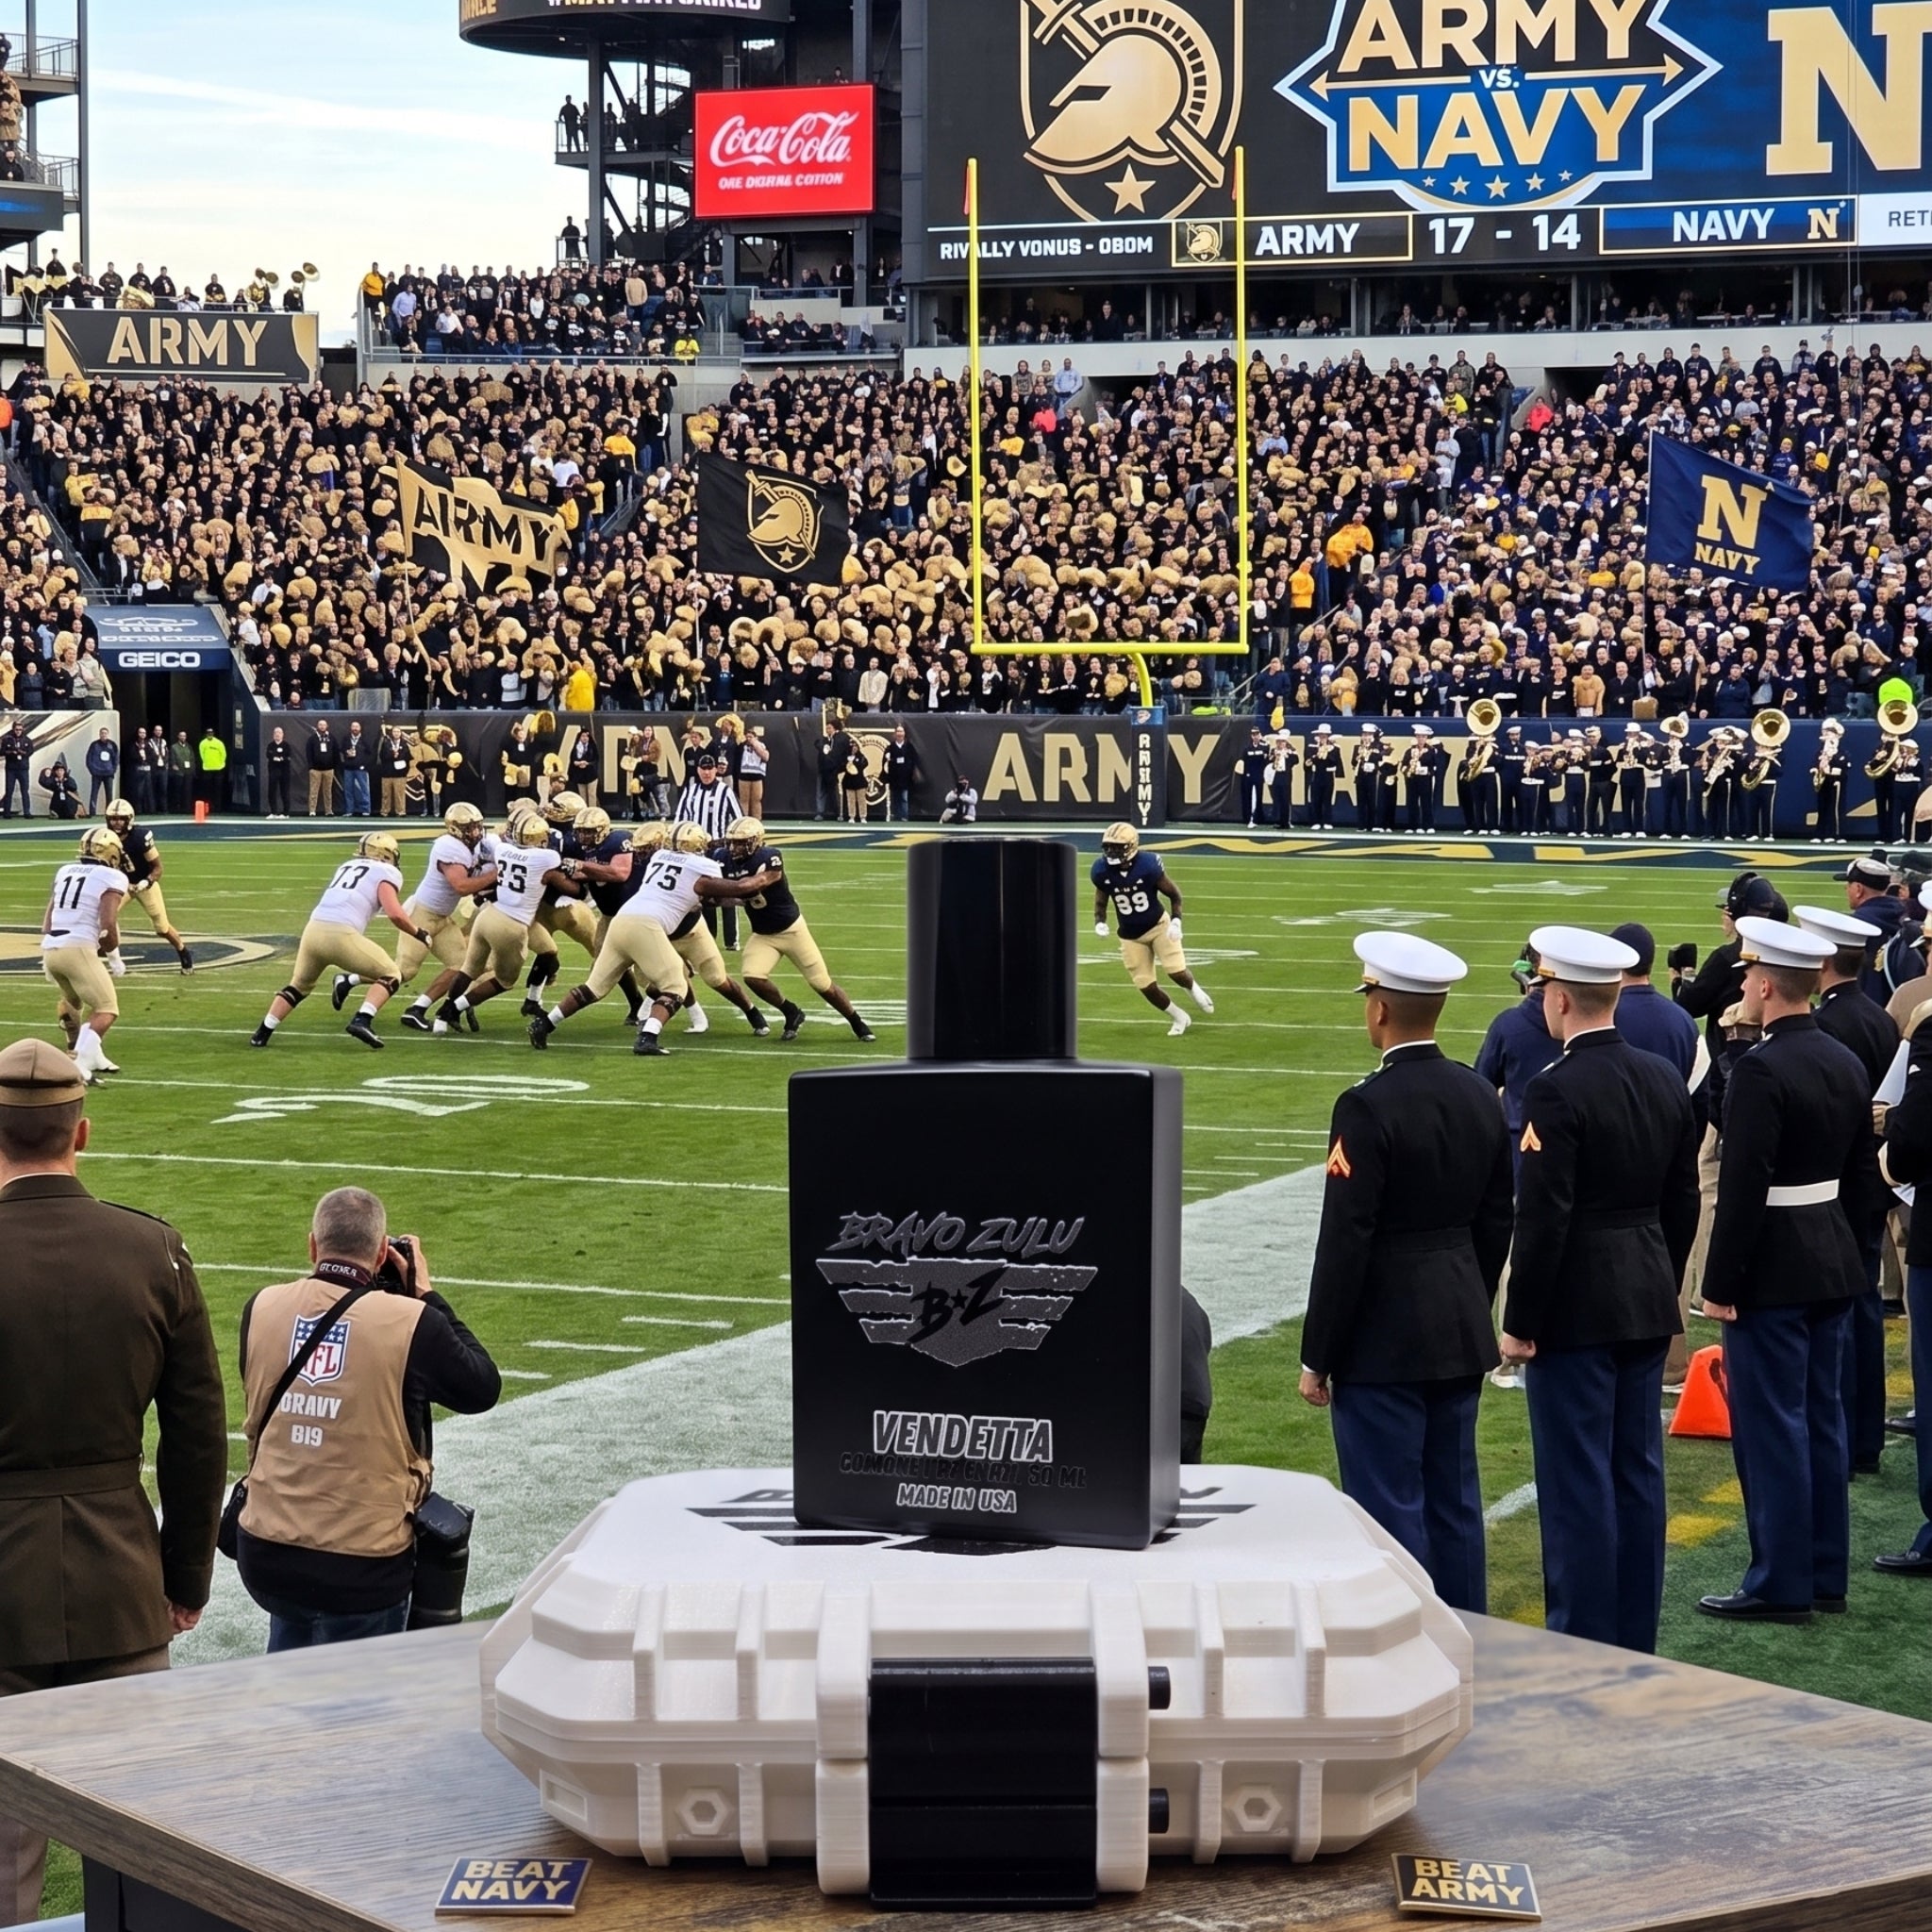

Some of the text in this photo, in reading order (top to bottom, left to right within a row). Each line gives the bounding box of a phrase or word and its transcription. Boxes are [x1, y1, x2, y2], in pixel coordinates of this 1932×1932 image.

[1336, 0, 1647, 73] ARMY
[1766, 1, 1932, 175] N
[1349, 84, 1647, 172] NAVY
[1428, 216, 1474, 255] 17
[1532, 213, 1581, 252] 14
[1673, 208, 1775, 242] NAVY
[1807, 207, 1840, 240] N
[1889, 209, 1932, 227] RET
[1019, 238, 1081, 258] VONUS
[1255, 223, 1359, 256] ARMY
[106, 316, 268, 366] ARMY
[1696, 474, 1768, 549] N
[1693, 541, 1761, 575] NAVY
[118, 651, 201, 668] GEICO
[59, 875, 86, 909] 11
[825, 1211, 1085, 1258] BRAVO ZULU
[297, 1343, 337, 1376] FL
[874, 1410, 1053, 1462] VENDETTA
[896, 1482, 1017, 1513] MADE IN USA
[463, 1858, 573, 1879] BEAT
[1414, 1858, 1511, 1883] BEAT
[451, 1880, 571, 1900] NAVY
[1411, 1877, 1524, 1906] ARMY
